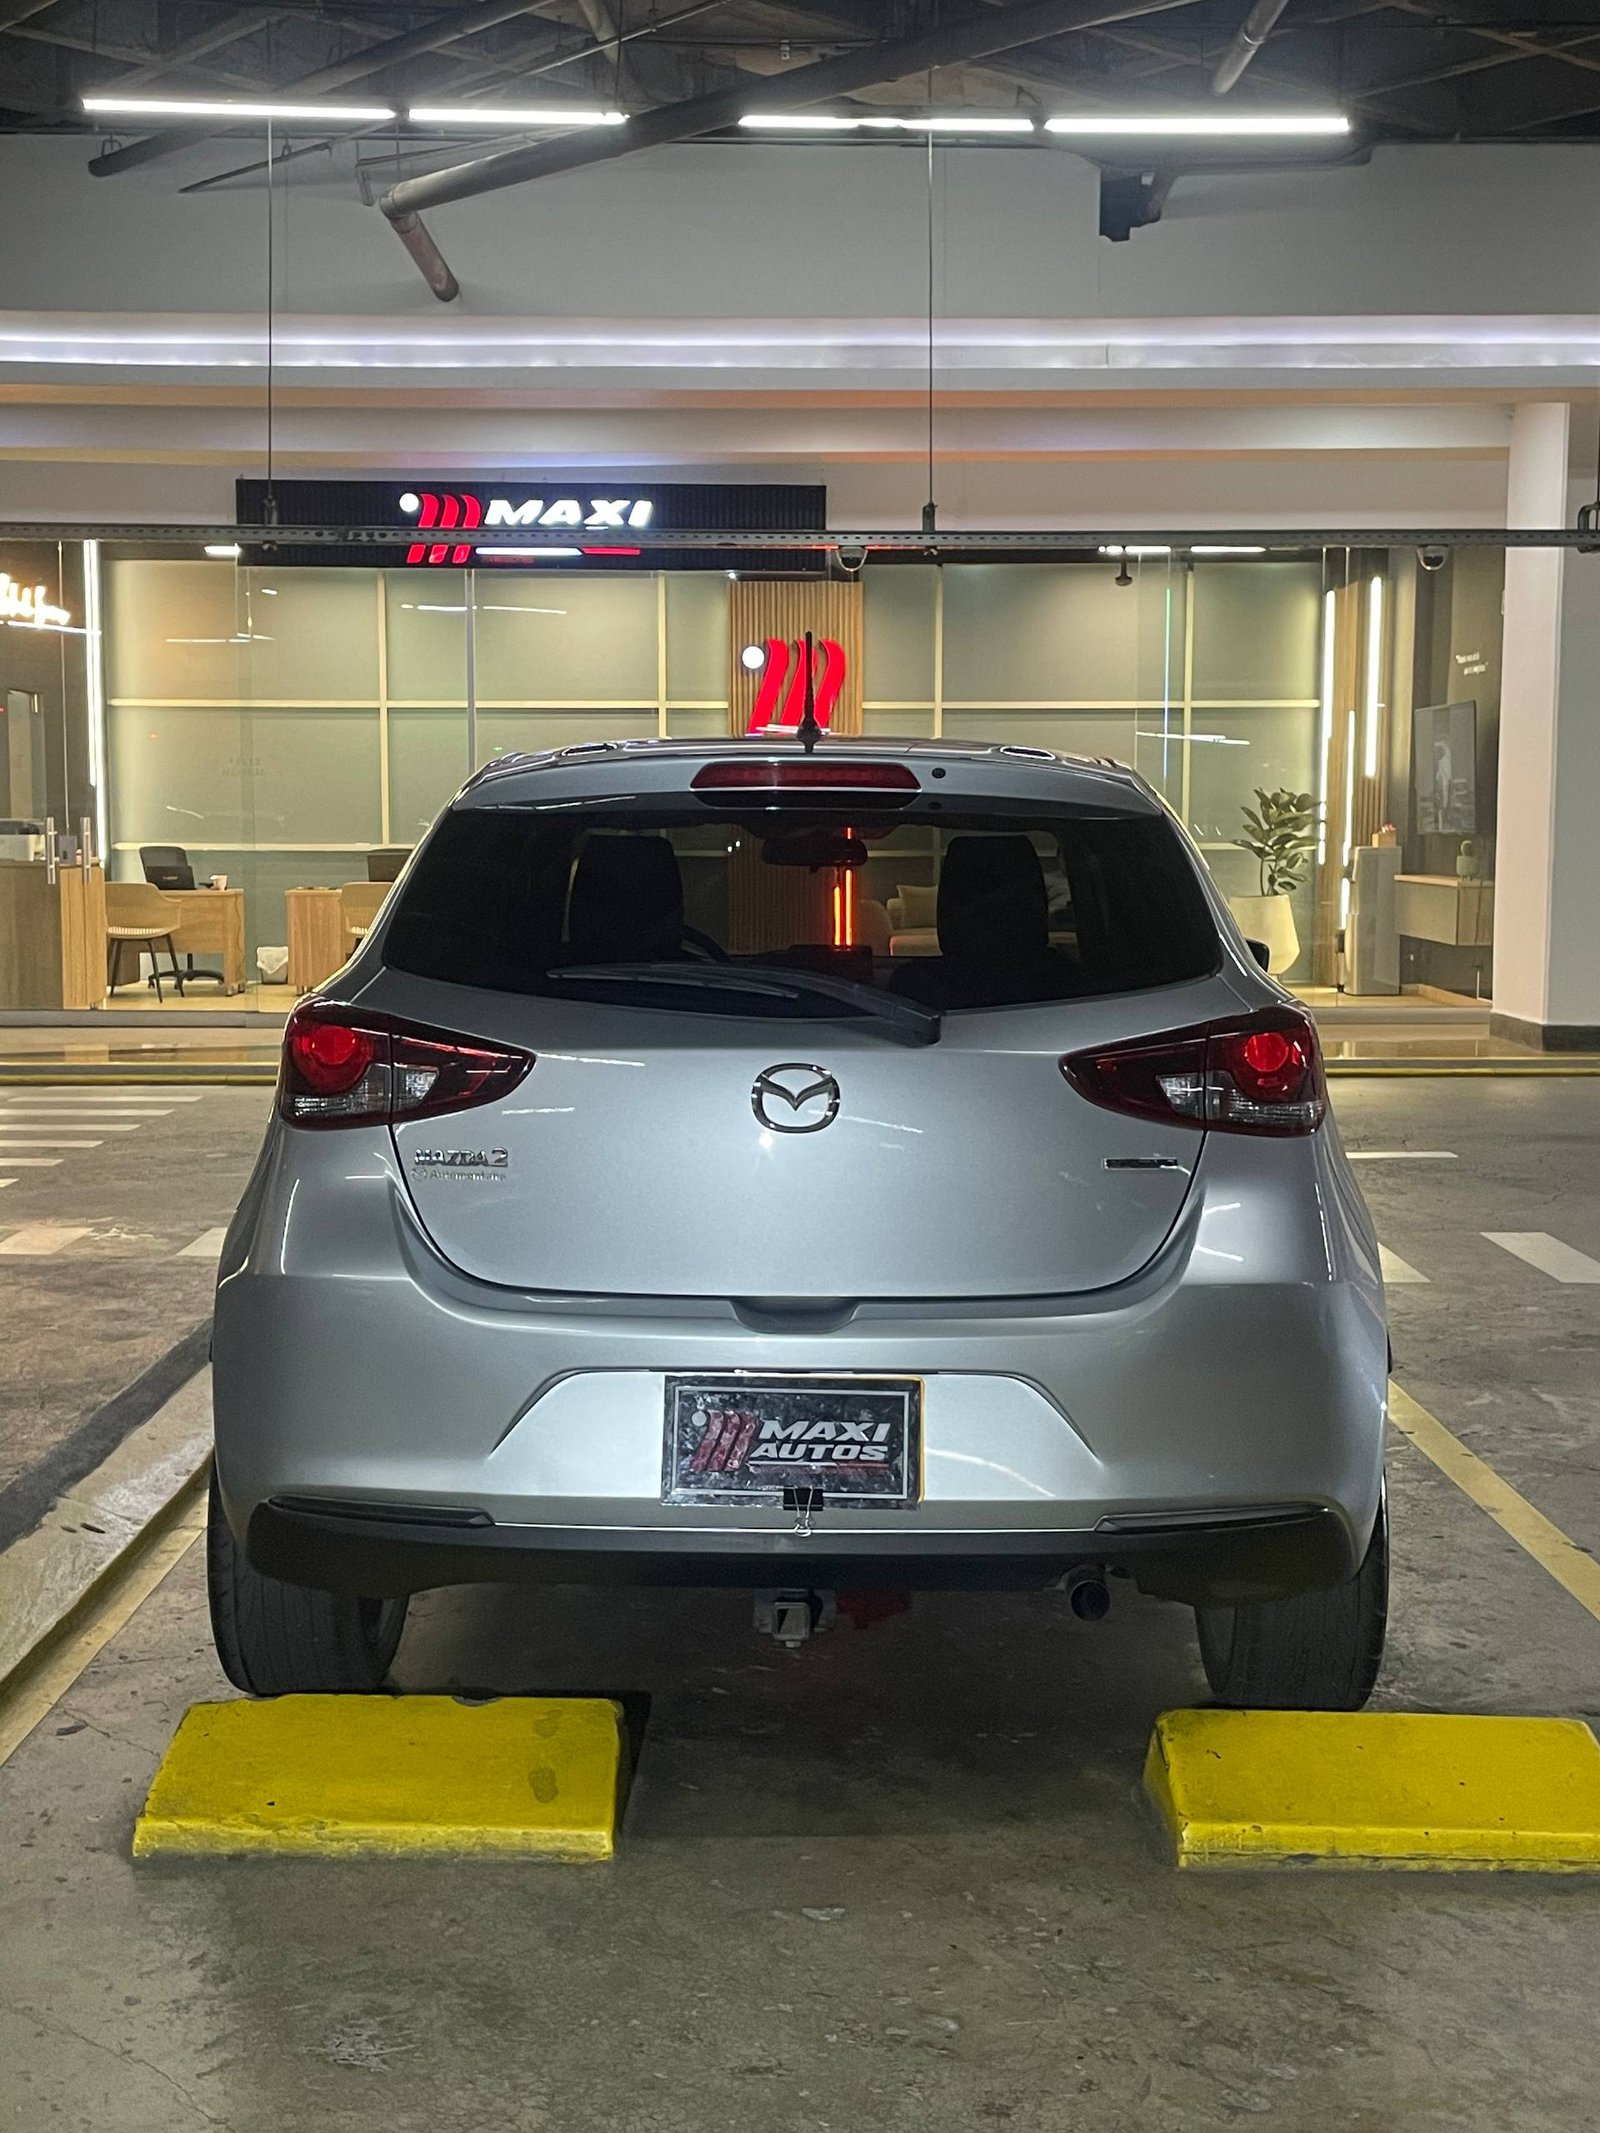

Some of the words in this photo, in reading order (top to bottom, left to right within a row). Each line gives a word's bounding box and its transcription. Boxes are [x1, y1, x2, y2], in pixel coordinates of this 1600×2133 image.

[484, 499, 653, 526] MAXI
[759, 1420, 891, 1442] MAXI
[750, 1442, 888, 1461] AUTOS
